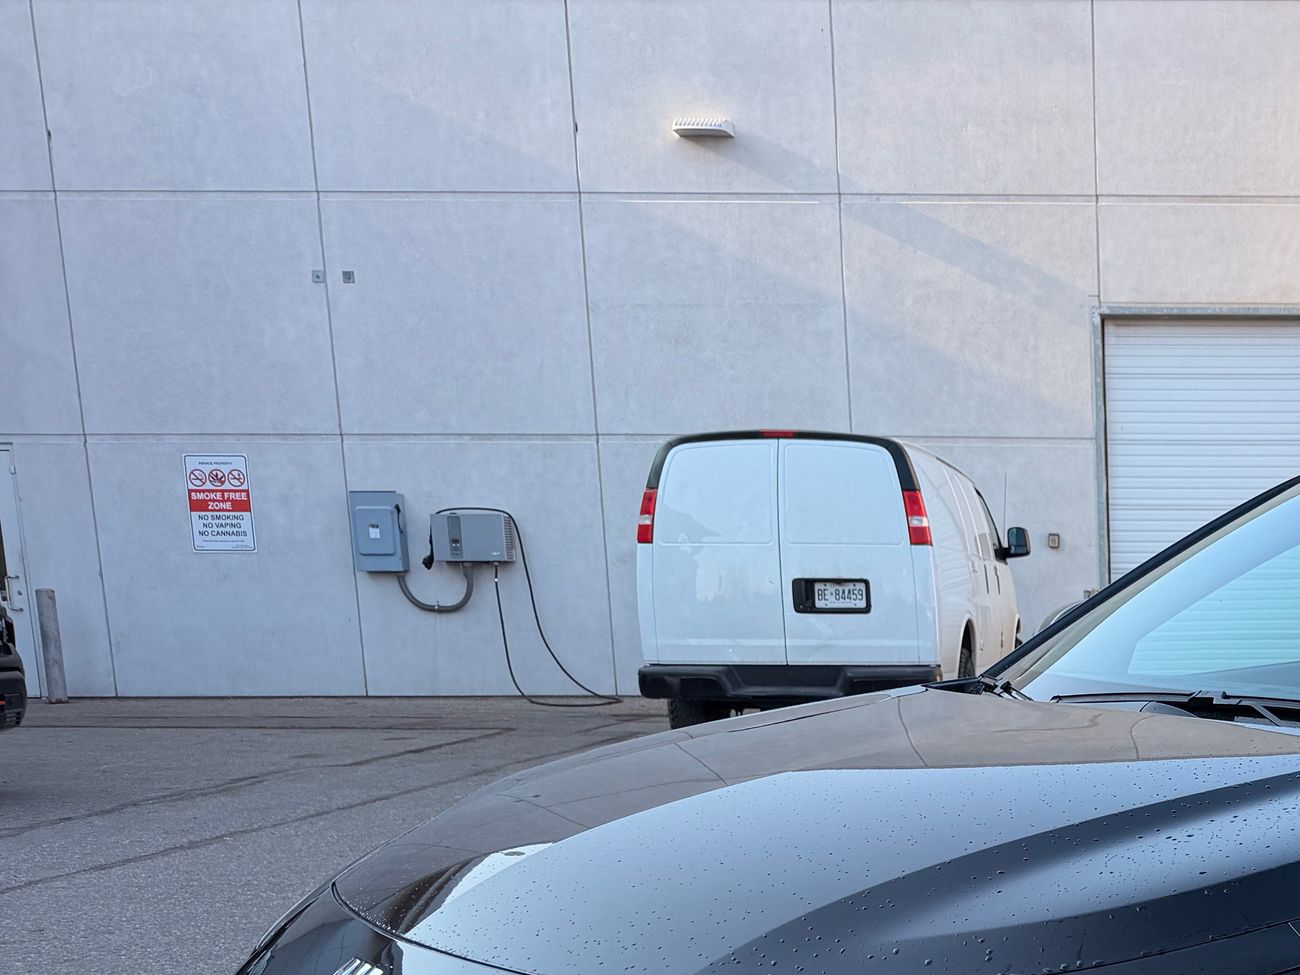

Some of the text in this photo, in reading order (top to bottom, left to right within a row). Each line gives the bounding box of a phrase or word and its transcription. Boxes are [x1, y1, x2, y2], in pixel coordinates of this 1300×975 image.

[191, 492, 247, 500] SMOKE FREE
[208, 502, 232, 510] ZONE
